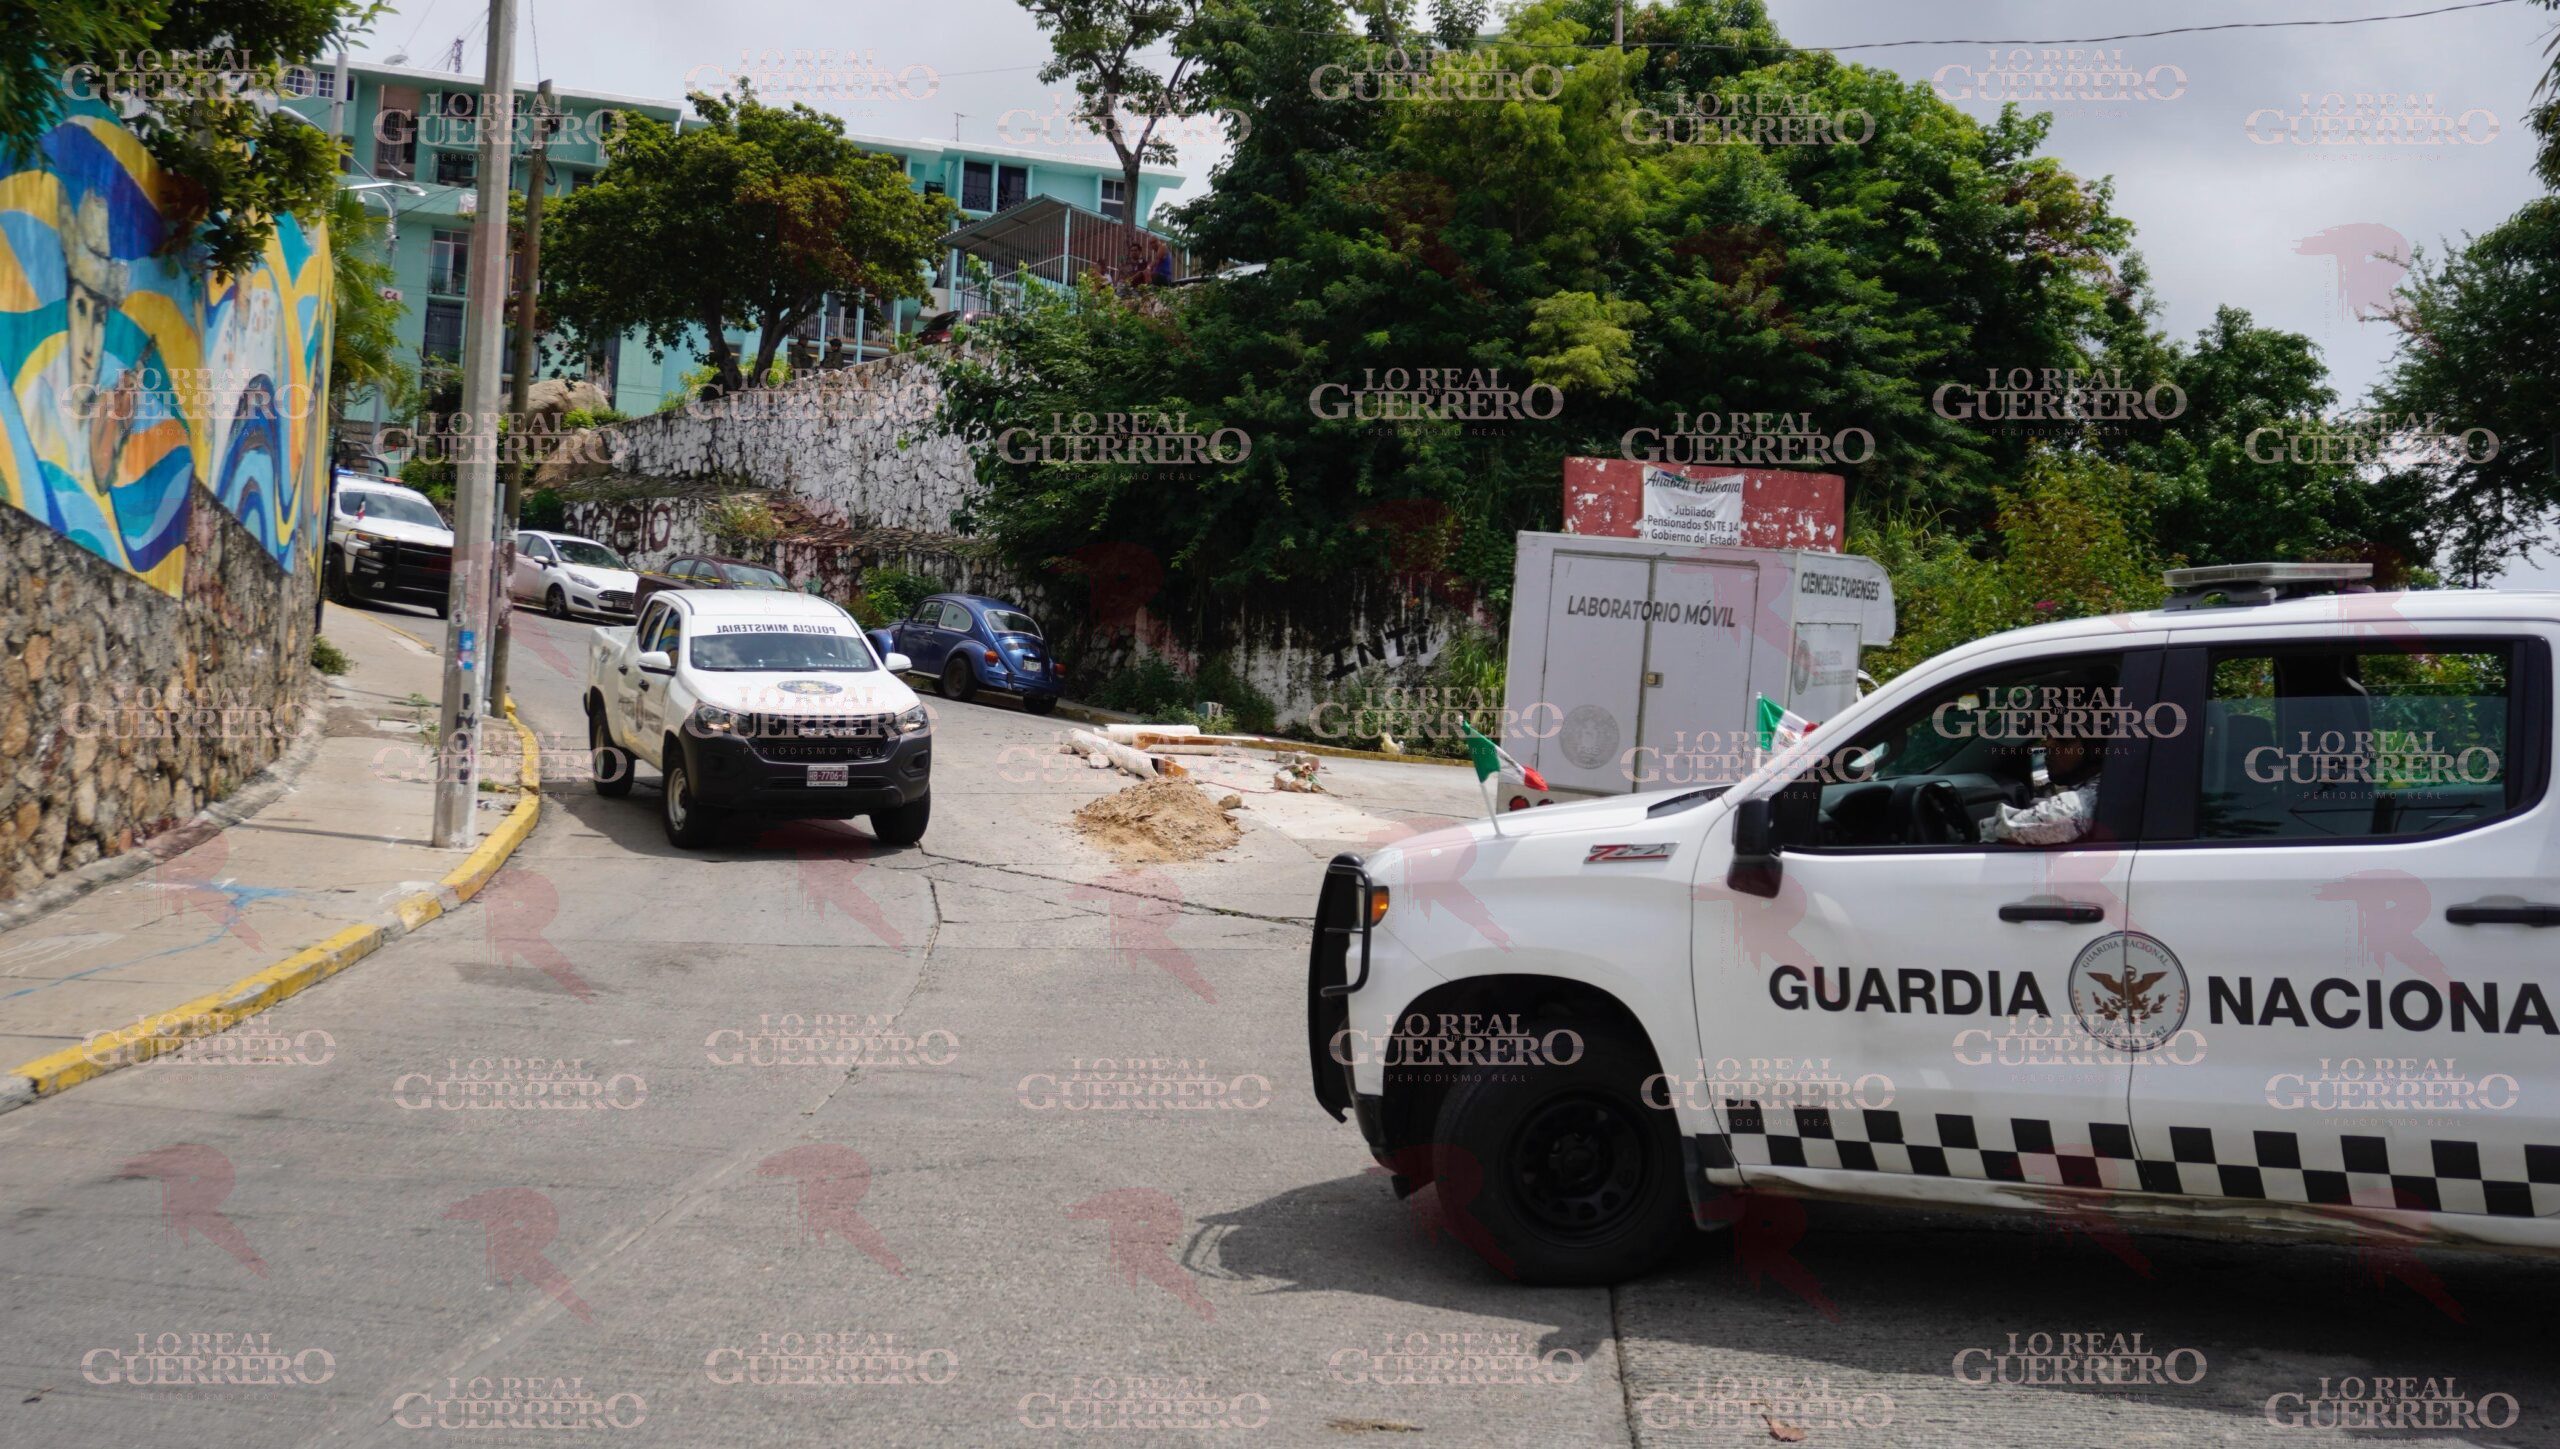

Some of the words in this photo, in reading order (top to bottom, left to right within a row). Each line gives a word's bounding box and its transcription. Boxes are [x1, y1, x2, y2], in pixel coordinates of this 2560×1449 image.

[1675, 505, 1716, 518] Jubilados
[1651, 529, 1691, 543] Gobierno
[1694, 533, 1707, 544] del
[1710, 534, 1738, 546] Estado
[1704, 521, 1727, 532] SNTE
[1729, 523, 1739, 533] 14
[1801, 572, 1840, 597] CIENCIAS
[1840, 577, 1880, 601] FORENSES
[1567, 595, 1681, 623] LABORATORIO
[1684, 600, 1736, 628] MÓVIL
[2081, 941, 2120, 969] GUARDIA
[2122, 939, 2169, 966] NACIONAL
[1769, 965, 2051, 1019] GUARDIA
[2209, 975, 2560, 1036] NACIONA
